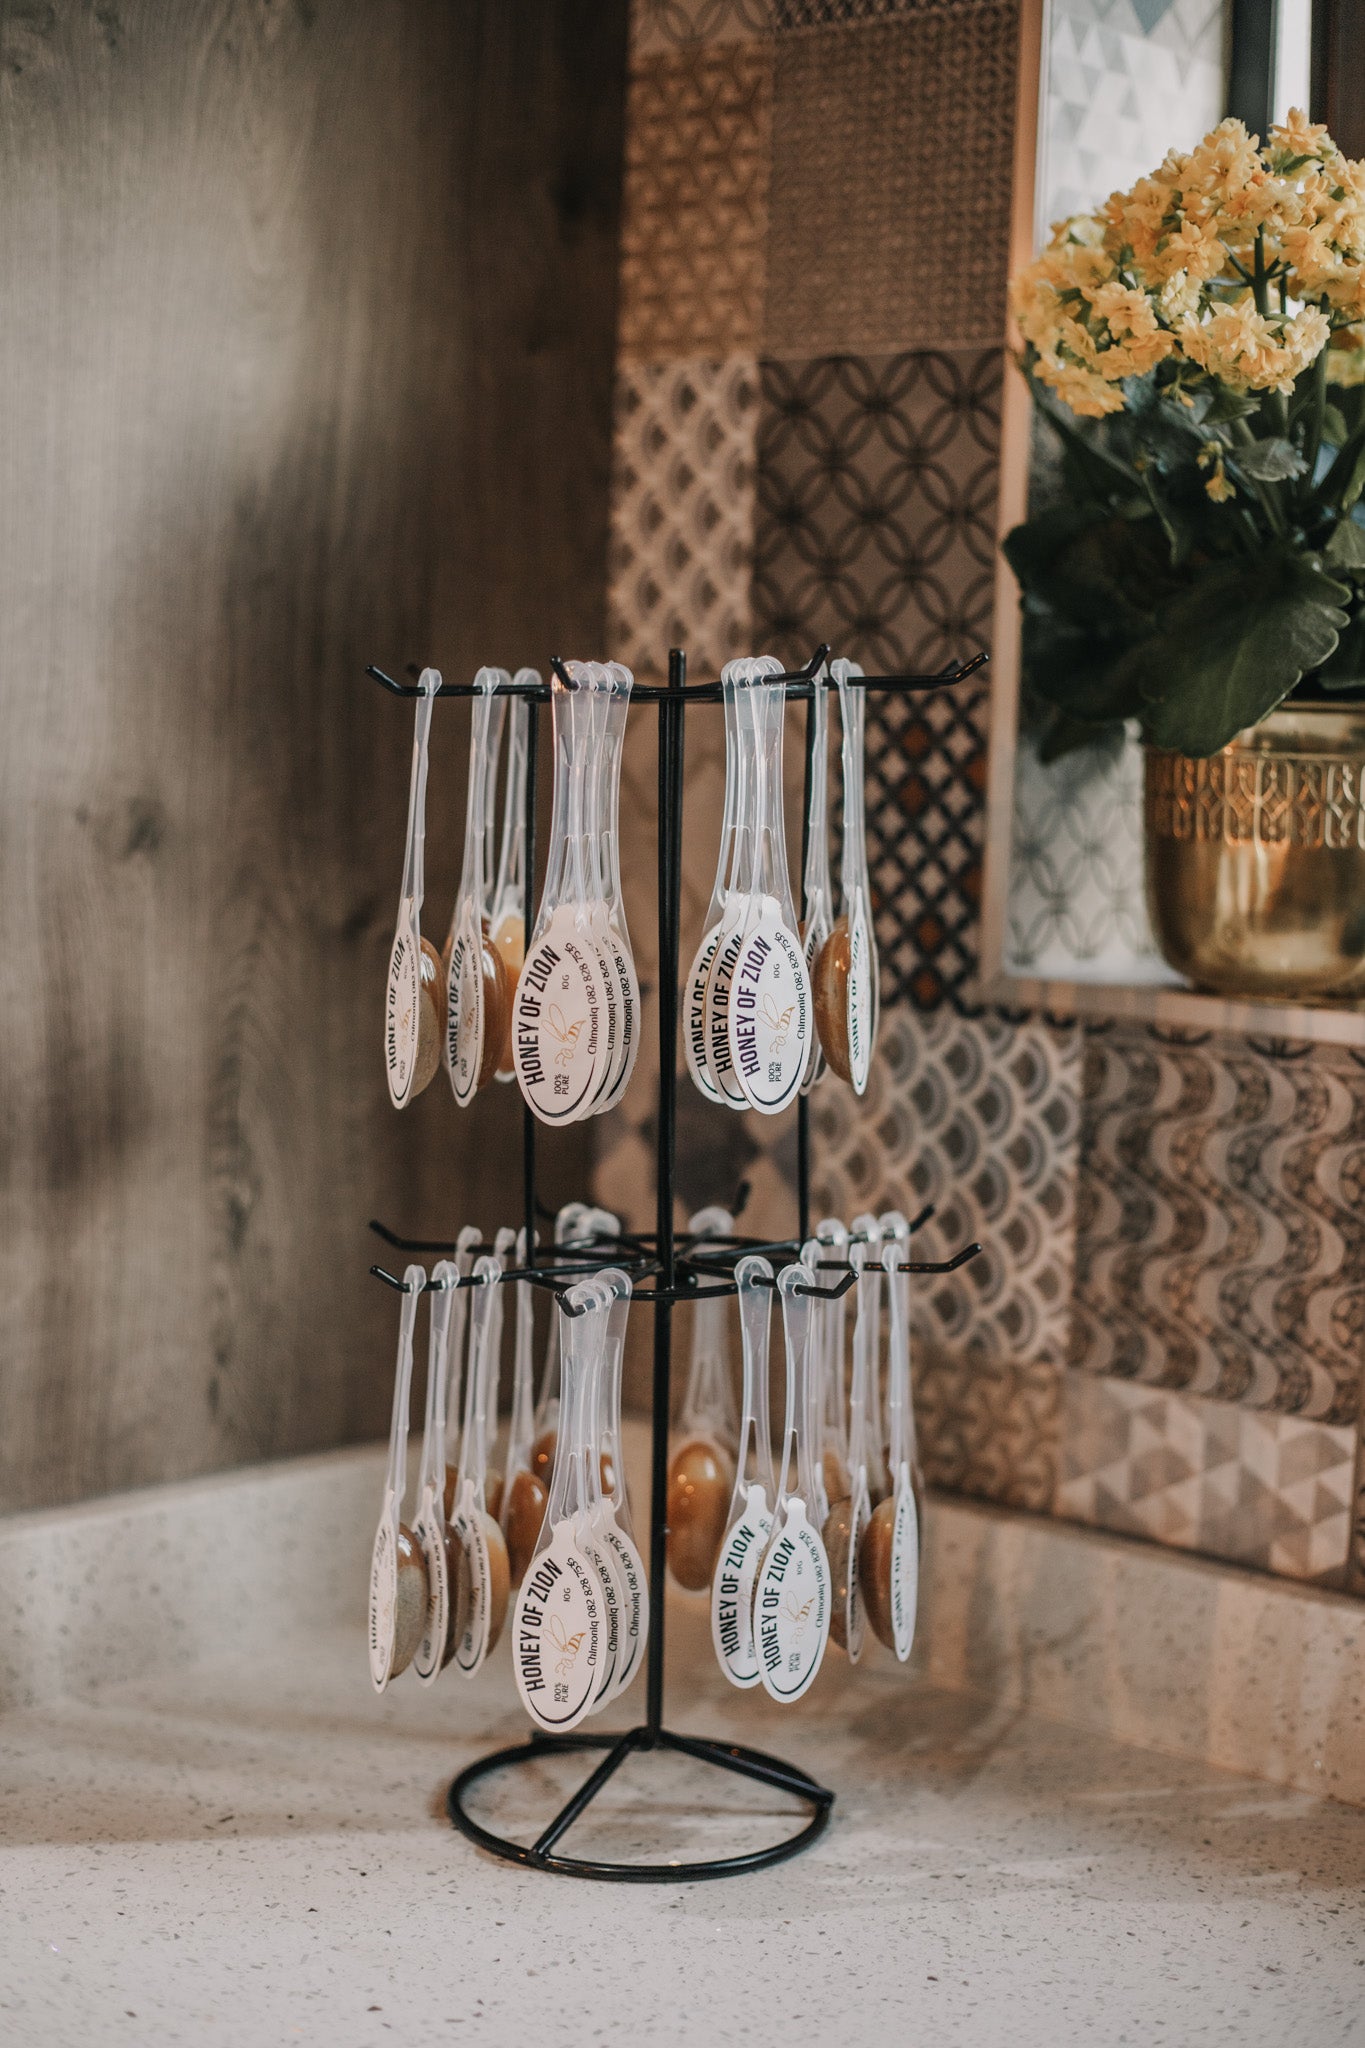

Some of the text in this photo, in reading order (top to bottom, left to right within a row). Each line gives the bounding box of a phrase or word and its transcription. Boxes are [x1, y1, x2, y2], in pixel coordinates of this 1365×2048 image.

[391, 936, 406, 982] ZION
[614, 956, 627, 975] 828
[787, 951, 800, 970] 828
[561, 974, 570, 990] 10G
[579, 962, 593, 982] 828
[794, 971, 805, 991] 082
[389, 987, 397, 1005] OF
[585, 984, 597, 1005] 082
[620, 977, 631, 997] 082
[713, 983, 730, 1009] OF
[449, 936, 467, 1068] HONEY OF ZION
[736, 936, 772, 1078] HONEY OF ZION
[518, 944, 562, 1086] HONEY OF ZION
[388, 1010, 398, 1070] HONEY
[587, 1006, 600, 1055] Chimoniq
[712, 1012, 733, 1074] HONEY
[554, 1073, 563, 1095] 100%
[562, 1074, 570, 1095] PURE
[620, 1551, 634, 1570] 828
[599, 1565, 612, 1584] 828
[627, 1571, 638, 1591] 082
[563, 1587, 571, 1602] 10G
[580, 1577, 593, 1596] 828
[605, 1586, 616, 1605] 082
[719, 1525, 756, 1657] HONEY OF ZION
[587, 1599, 598, 1618] 082
[761, 1537, 796, 1672] HONEY OF ZION
[520, 1558, 563, 1692] HONEY OF ZION
[561, 1683, 569, 1703] PURE
